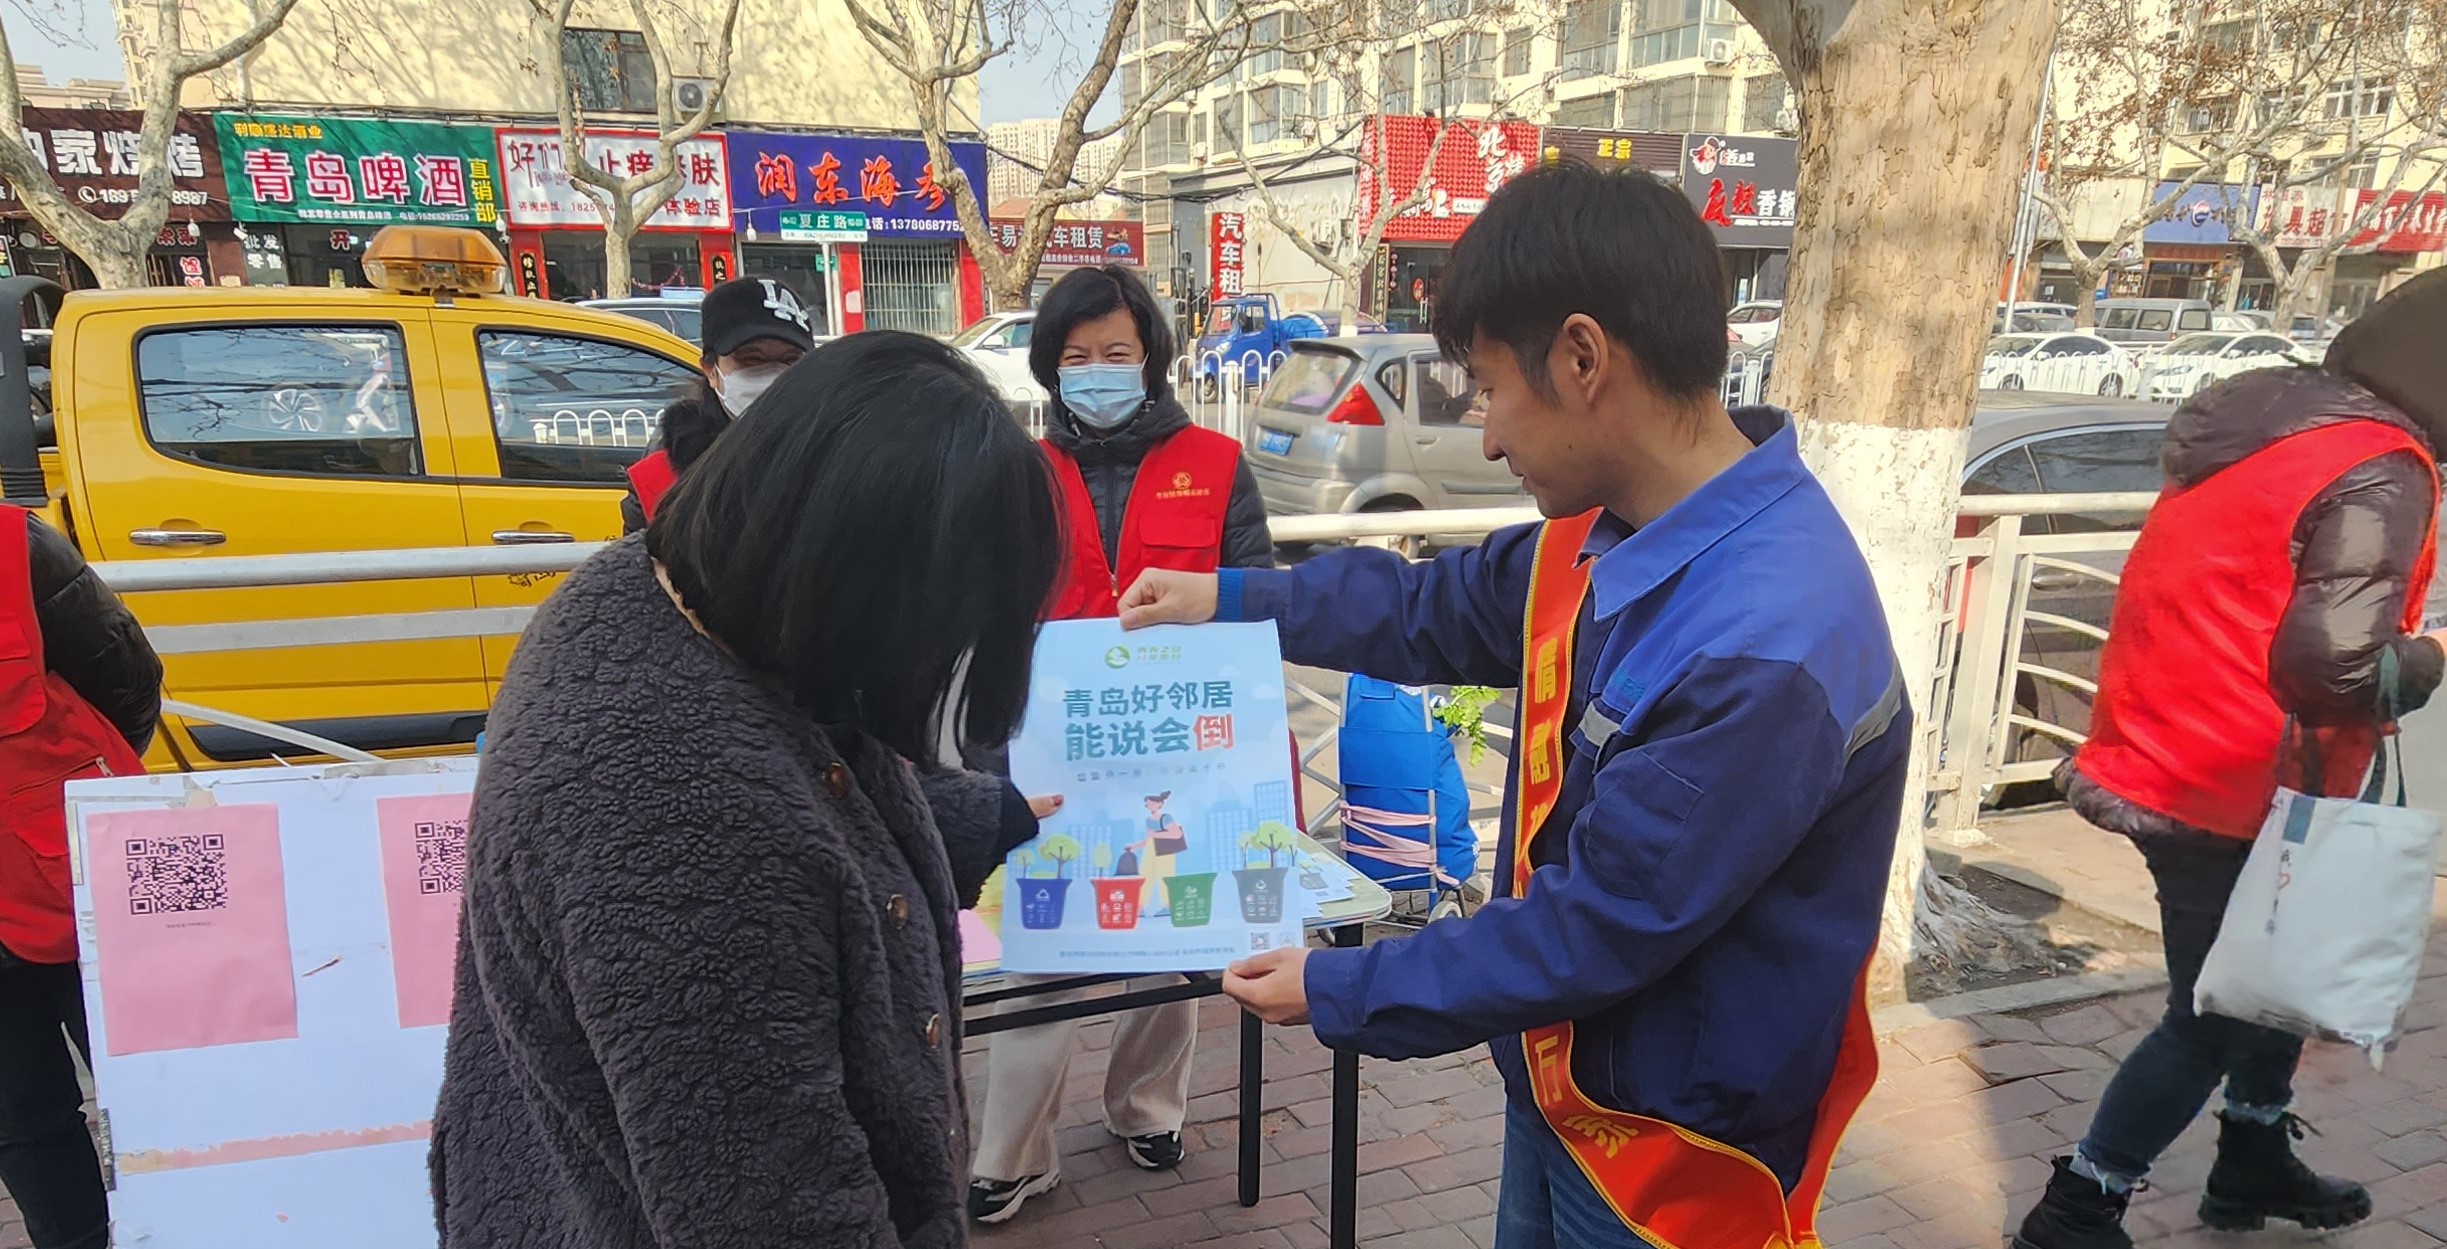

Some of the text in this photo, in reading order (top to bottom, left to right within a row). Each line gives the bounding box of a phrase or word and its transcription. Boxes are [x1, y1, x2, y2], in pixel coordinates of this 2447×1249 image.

[1597, 138, 1633, 160] 正宗
[243, 148, 467, 207] 青岛啤酒
[598, 149, 720, 187] 止痒肤
[468, 158, 497, 223] 直销部
[663, 197, 721, 217] 体验店
[798, 213, 848, 230] 夏庄路
[244, 235, 280, 250] 批发
[988, 223, 1103, 249] 车易车租赁
[247, 253, 283, 269] 零售
[1062, 680, 1233, 718] 青岛好邻居
[1064, 713, 1235, 761] 能说会倒
